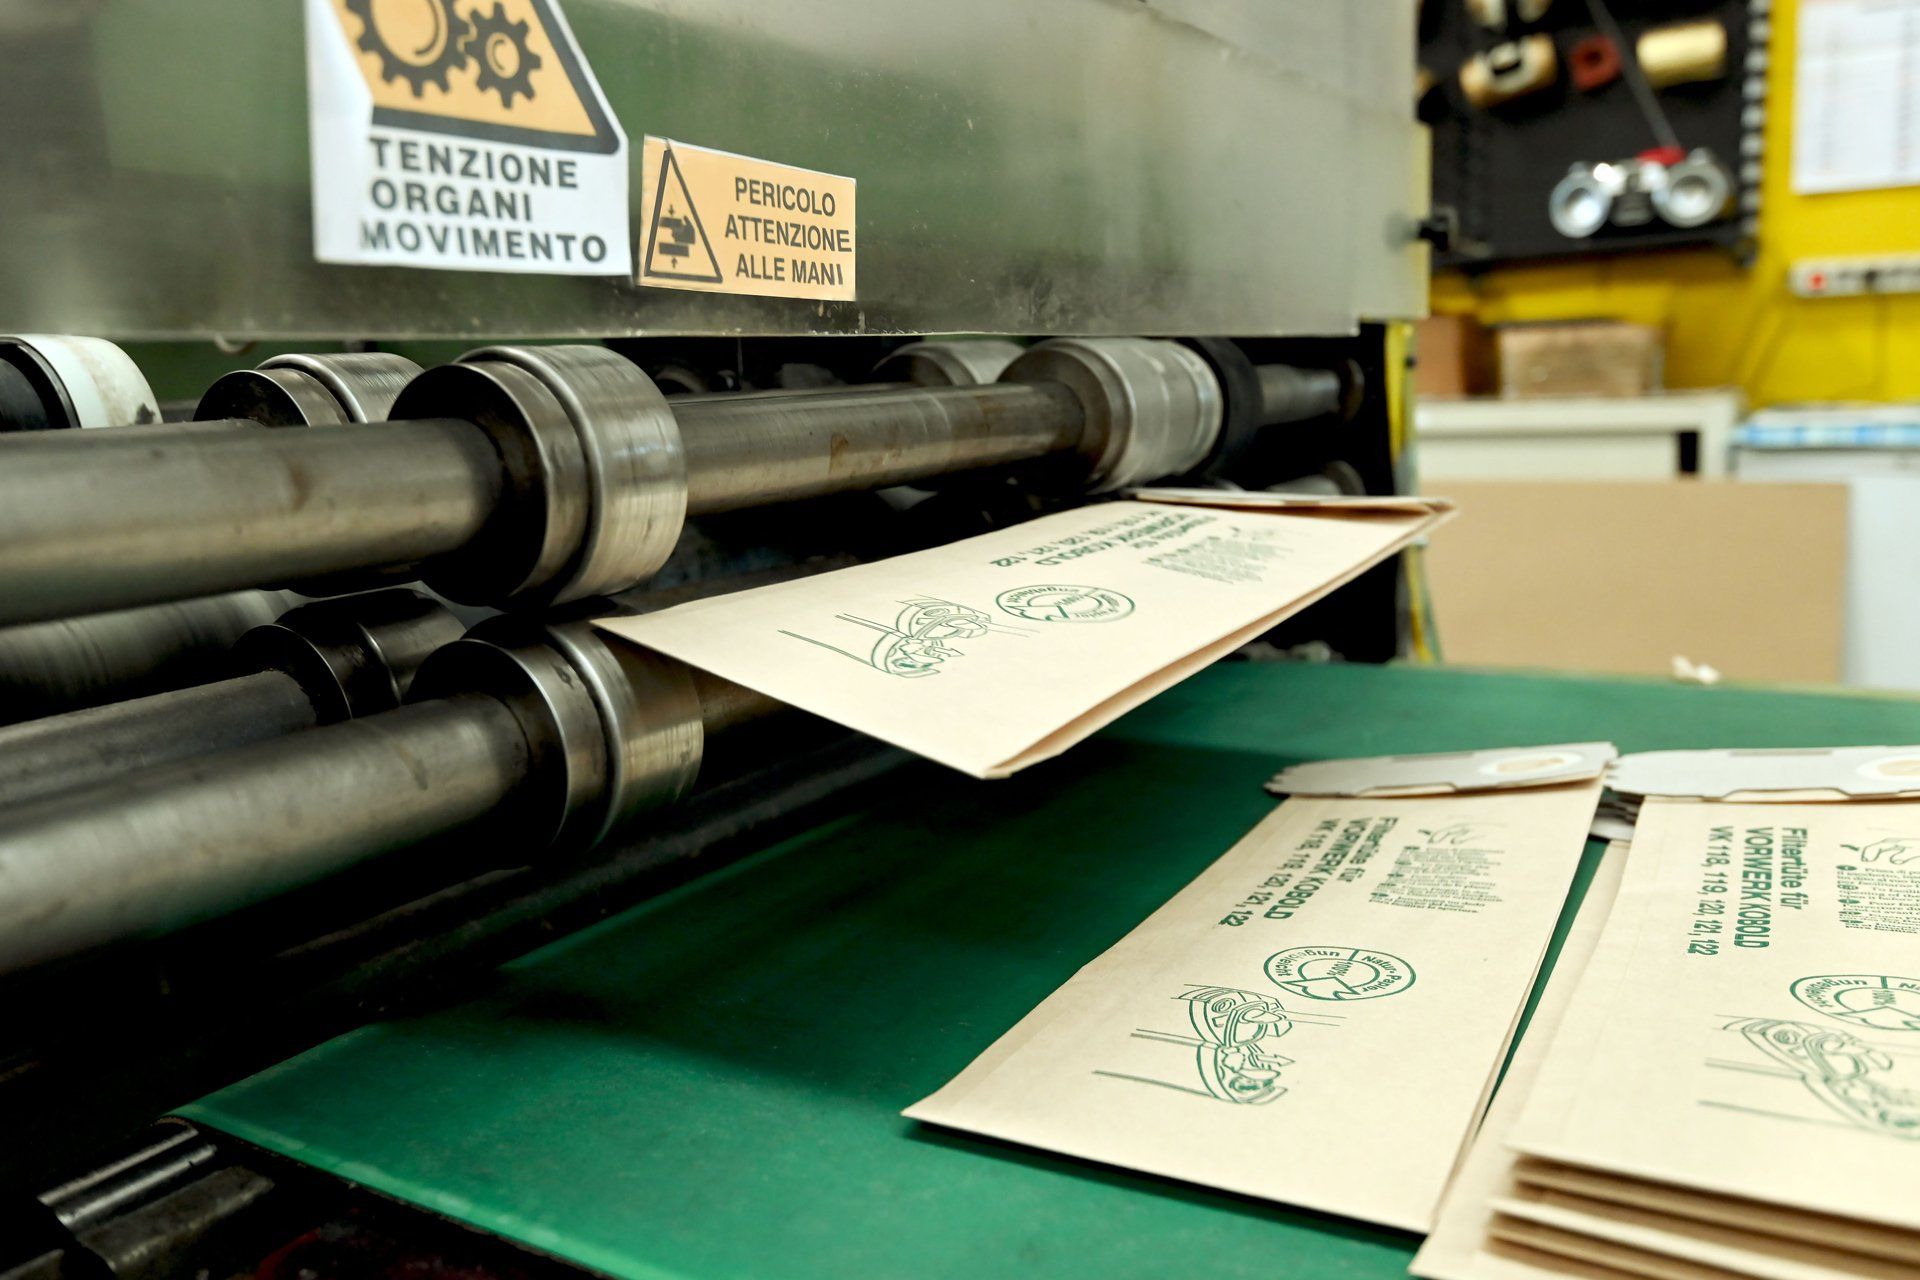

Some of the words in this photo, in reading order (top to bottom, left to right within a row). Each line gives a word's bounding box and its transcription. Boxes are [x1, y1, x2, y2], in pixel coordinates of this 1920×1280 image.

[368, 137, 578, 189] TENZIONE
[371, 178, 532, 222] ORGANI
[734, 176, 837, 218] PERICOLO
[359, 219, 608, 264] MOVIMENTO
[725, 215, 852, 254] ATTENZIONE
[735, 254, 786, 283] ALLE
[791, 259, 845, 286] MANI
[1708, 825, 1735, 843] VK
[1701, 844, 1731, 867] 118,
[1740, 826, 1775, 902] VORWERK
[1780, 827, 1809, 889] Filtertüte
[1263, 875, 1329, 920] KOBOLD
[1696, 871, 1729, 895] 119,
[1779, 892, 1810, 910] für
[1217, 909, 1255, 928] 122
[1733, 902, 1772, 949] KOBOLD
[1686, 938, 1720, 956] 122
